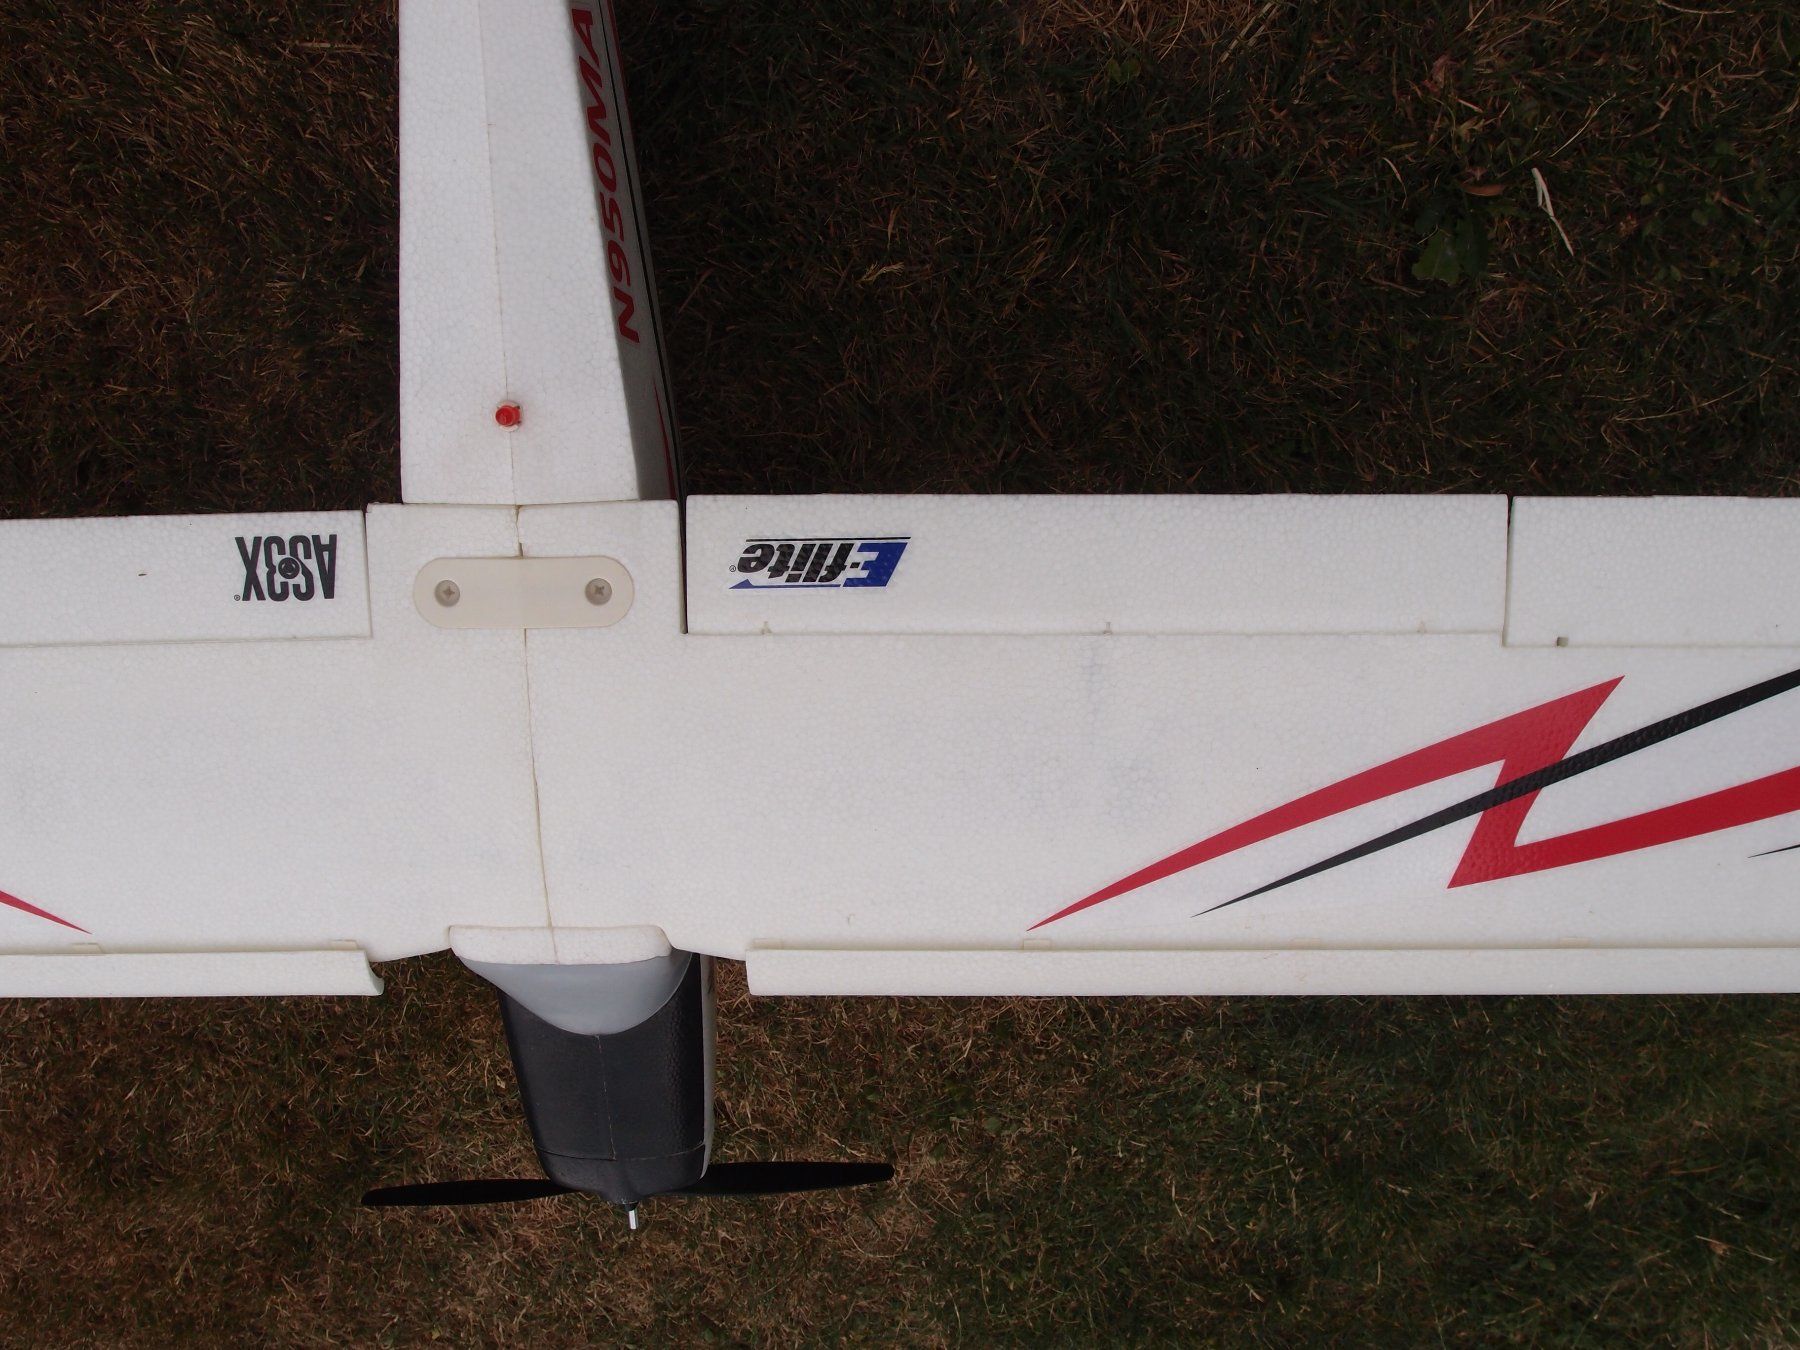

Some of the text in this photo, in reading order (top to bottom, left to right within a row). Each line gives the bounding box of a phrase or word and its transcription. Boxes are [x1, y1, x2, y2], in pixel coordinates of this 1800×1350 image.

[571, 8, 640, 343] N950MA
[234, 534, 338, 602] AS3X
[737, 542, 908, 587] E-flite
